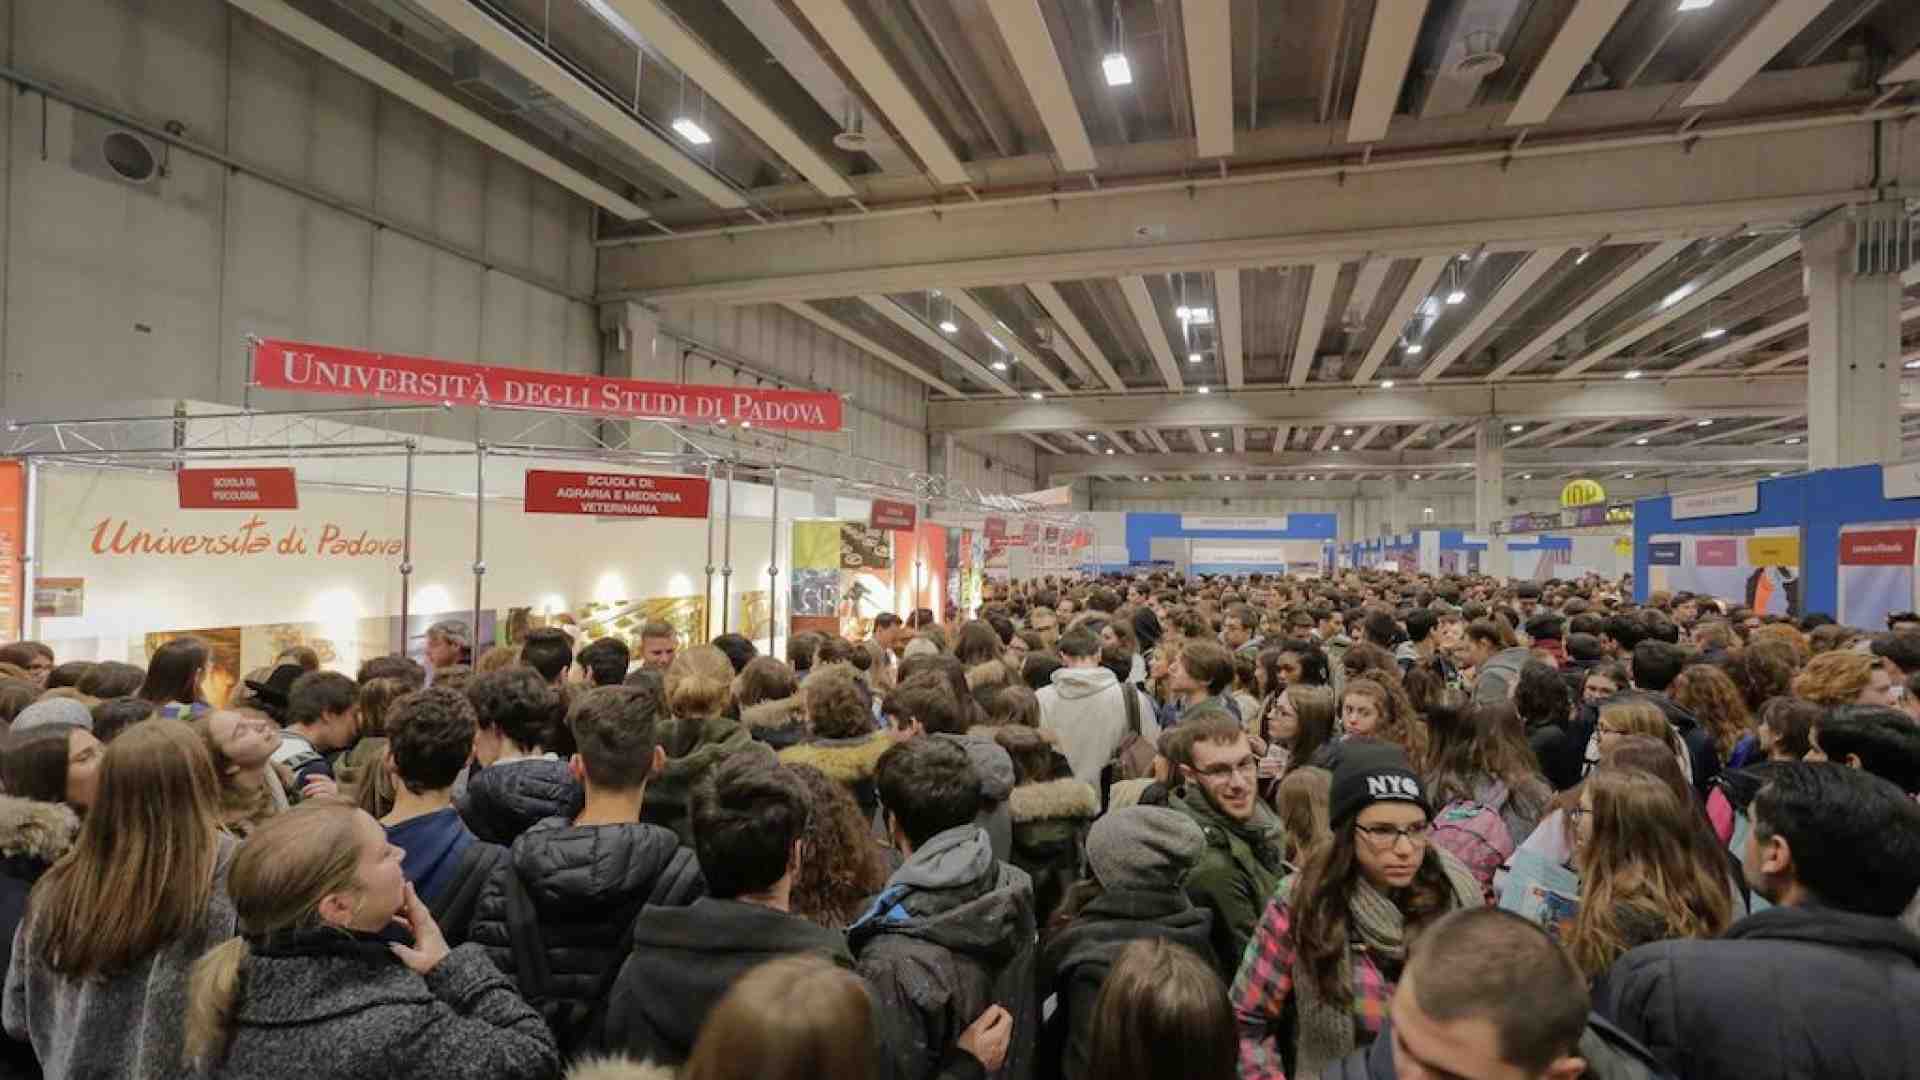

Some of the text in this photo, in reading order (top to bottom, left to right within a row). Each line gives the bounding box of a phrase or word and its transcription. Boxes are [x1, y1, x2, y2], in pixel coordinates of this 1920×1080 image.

[282, 350, 825, 424] UNIVERSITÀ DEGLI STUDI DI PADOVA
[586, 475, 636, 488] SCUOLA
[556, 487, 682, 502] AGRARIA E MEDICINA
[580, 501, 659, 515] VETERINARIA
[90, 514, 403, 556] Università di Padova
